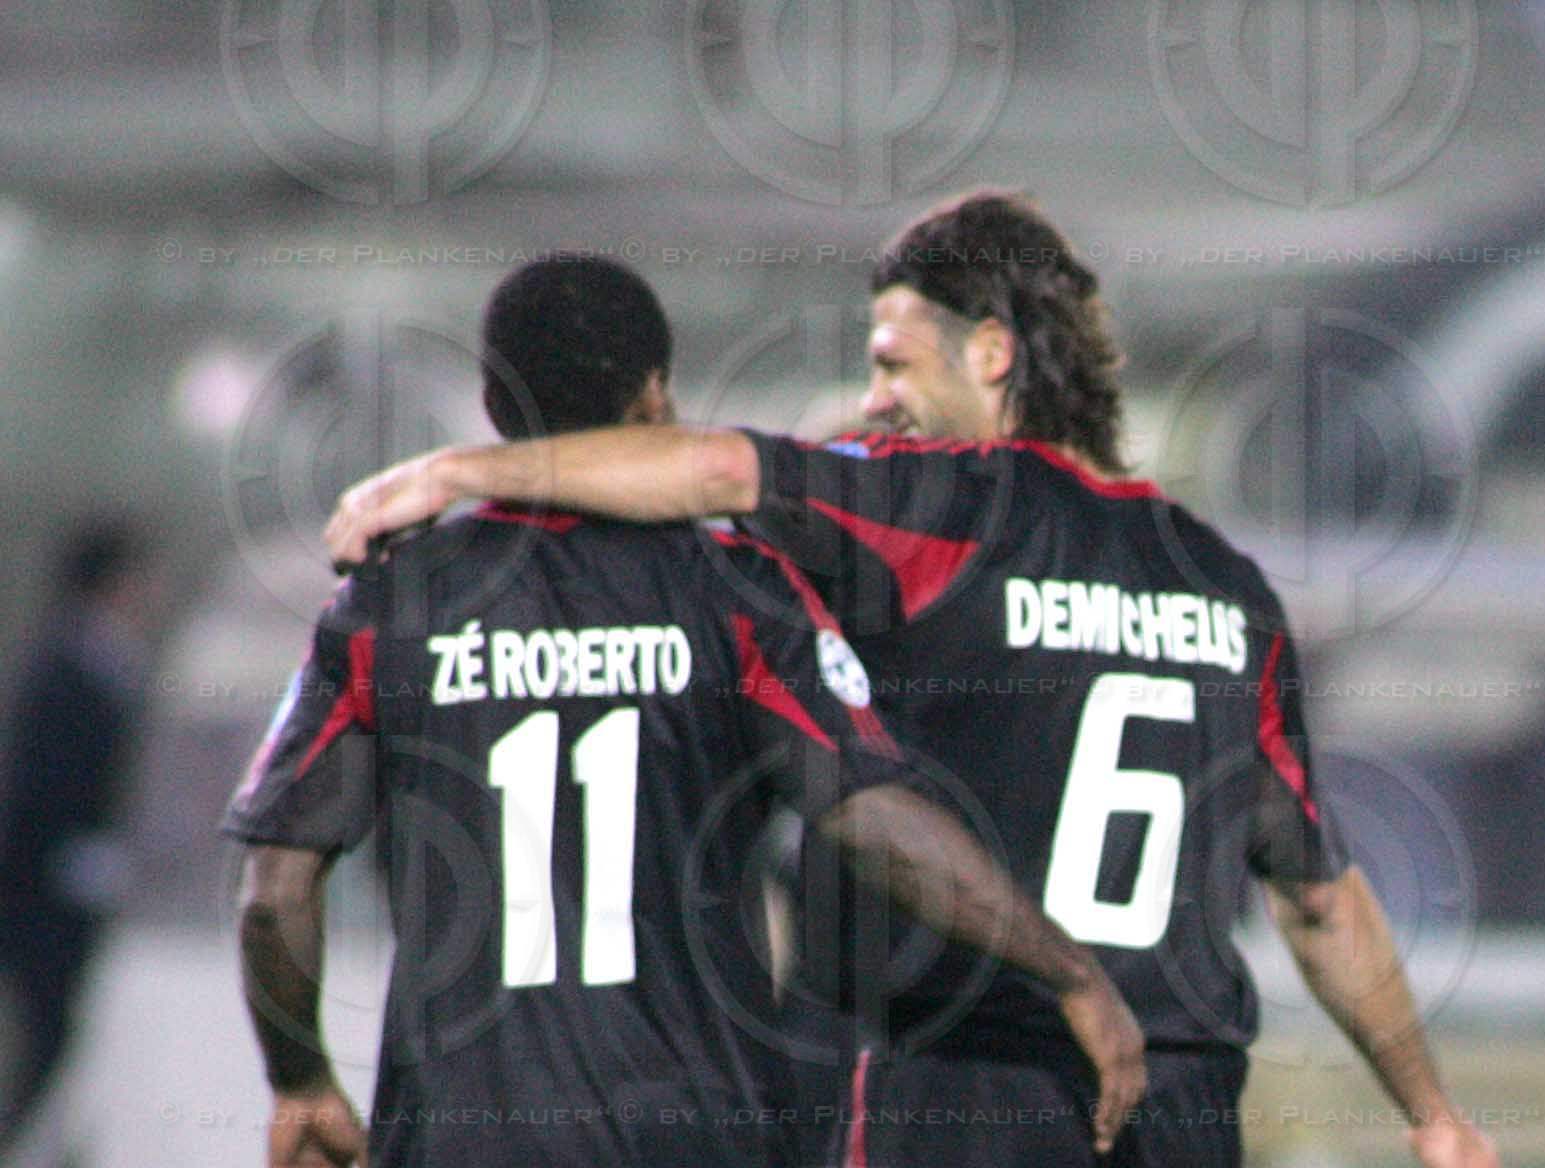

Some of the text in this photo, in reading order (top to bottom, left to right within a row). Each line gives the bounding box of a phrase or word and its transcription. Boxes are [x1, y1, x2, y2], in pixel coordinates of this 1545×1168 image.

[427, 619, 691, 704] ZÉ ROBERTO
[488, 707, 641, 988] 11
[1042, 672, 1195, 950] 6
